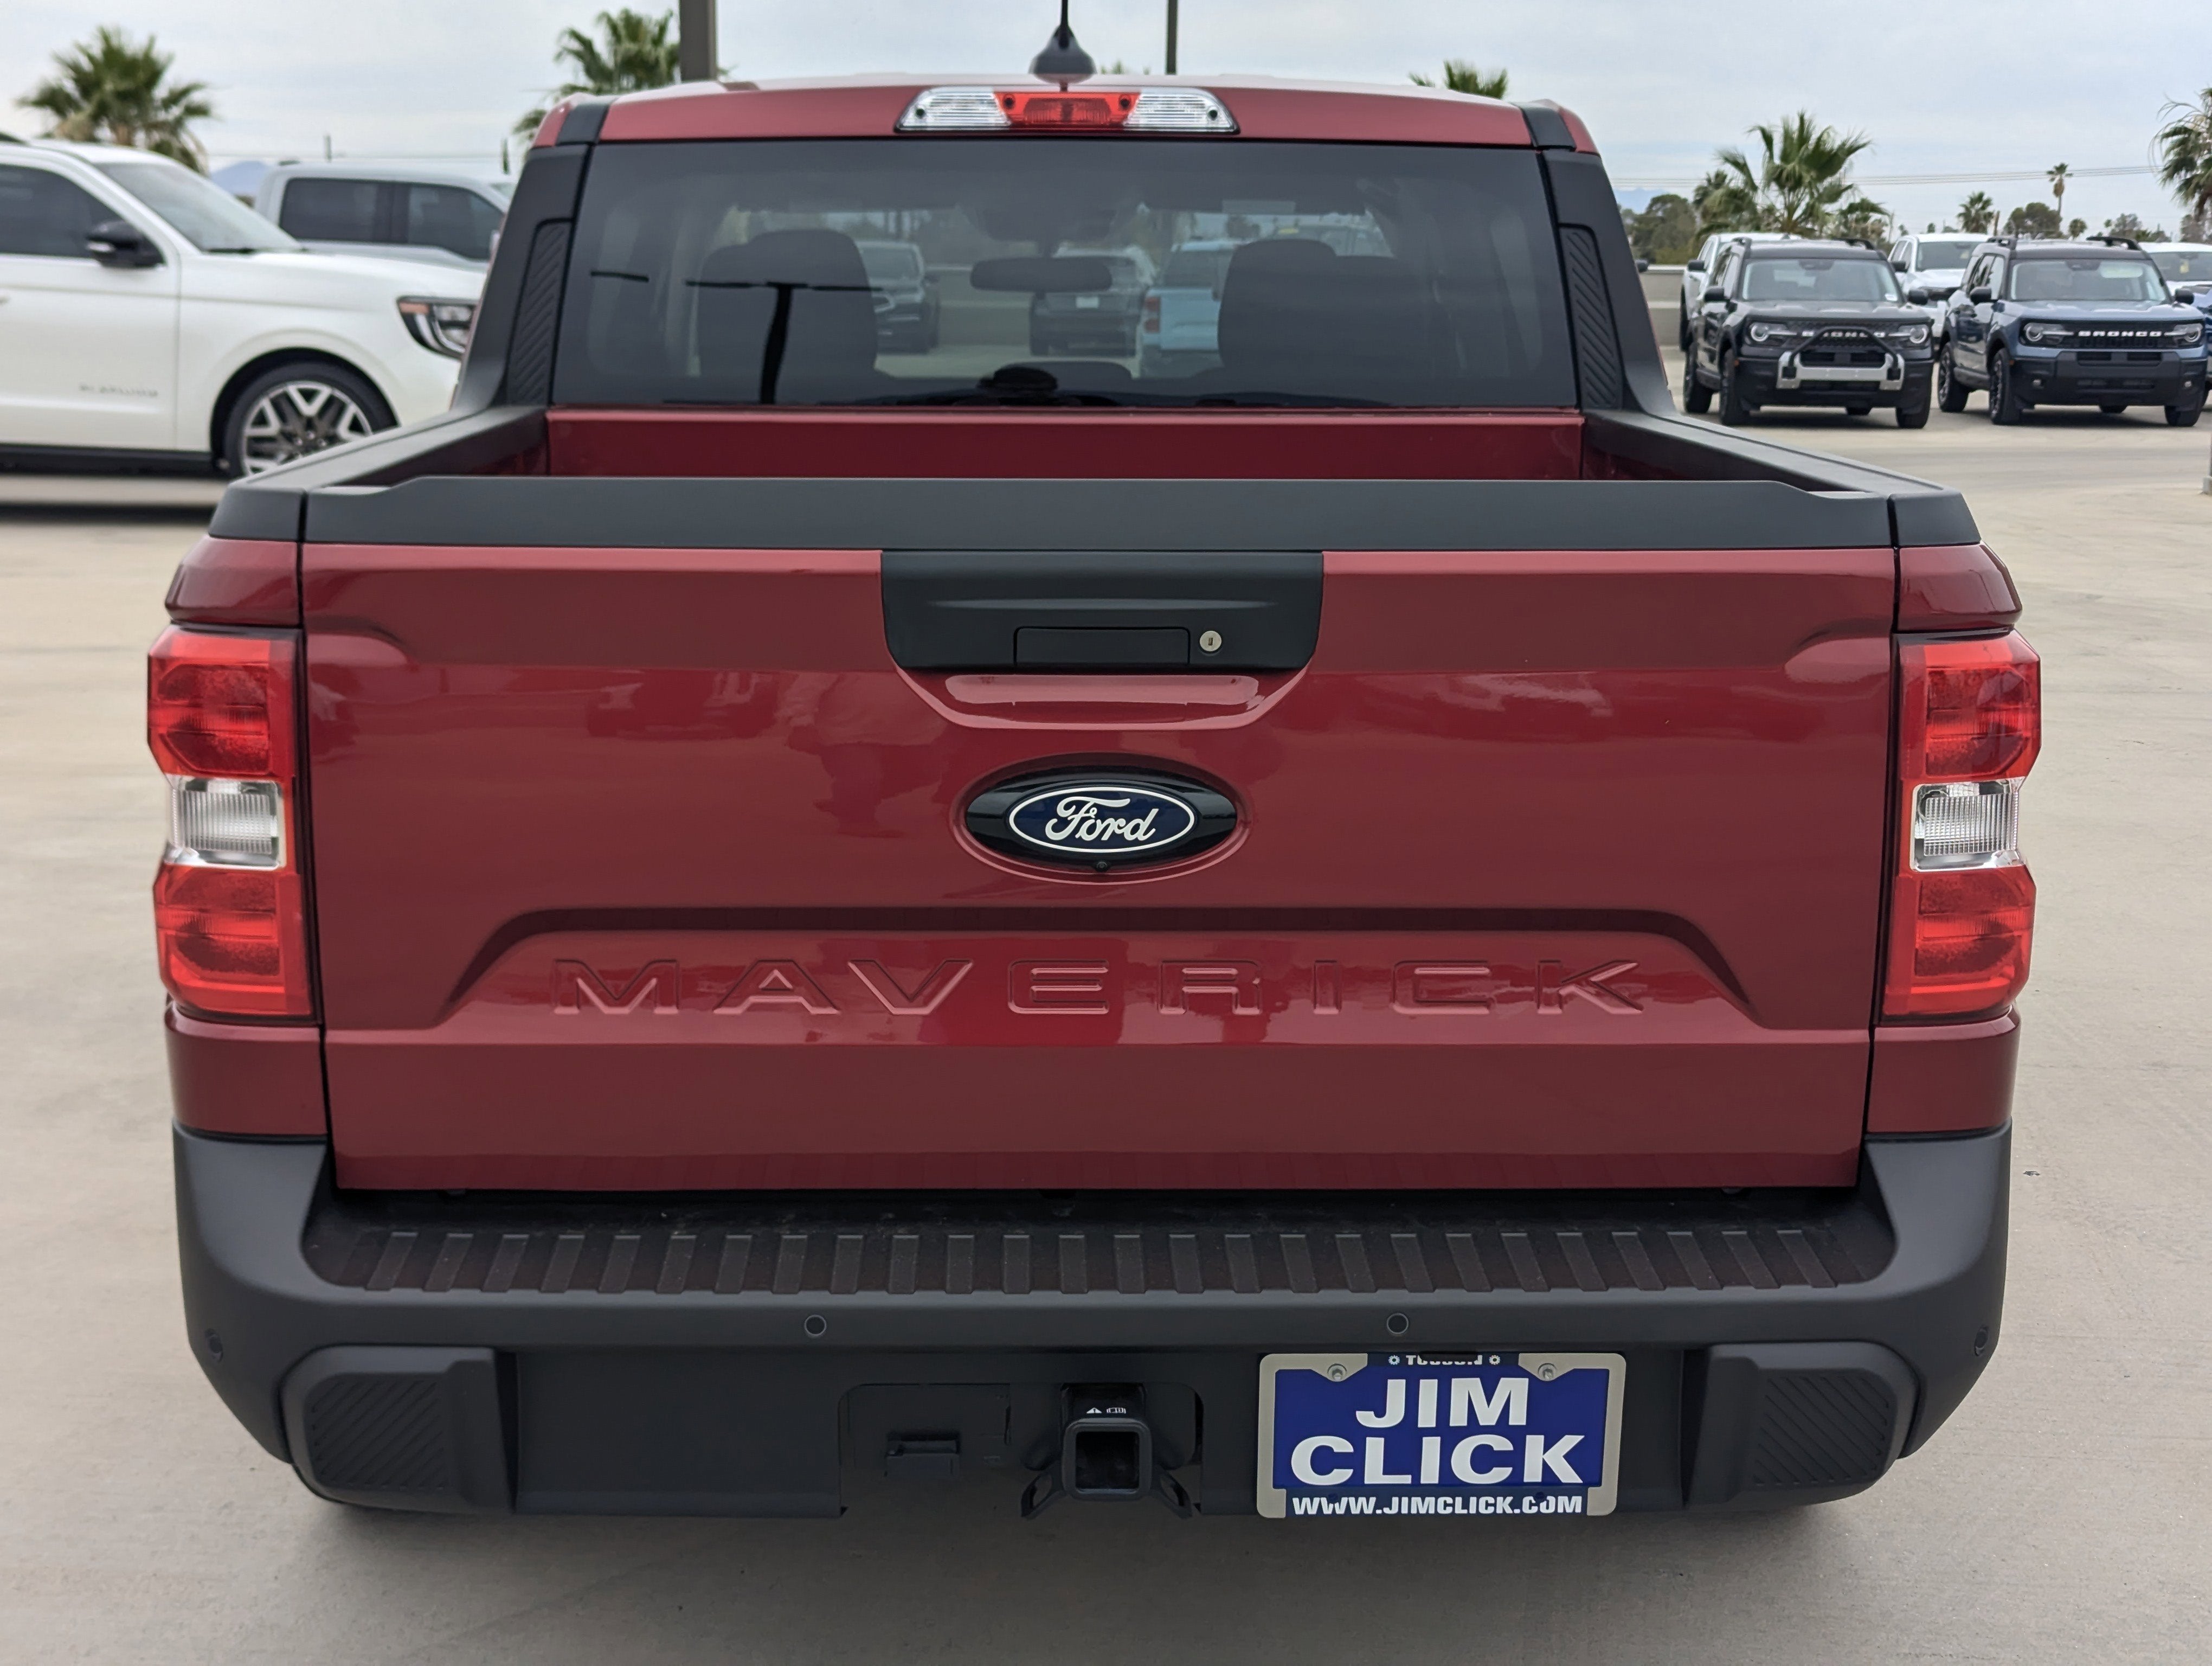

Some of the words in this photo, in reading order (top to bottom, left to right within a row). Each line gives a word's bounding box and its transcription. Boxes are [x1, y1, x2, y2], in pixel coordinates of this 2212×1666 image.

[1045, 796, 1159, 841] Ford
[552, 959, 1644, 1014] MAVERICK
[1356, 1377, 1529, 1428] JIM
[1291, 1434, 1585, 1485] CLICK
[1293, 1496, 1583, 1515] WWW.JIMCLICK.COM
